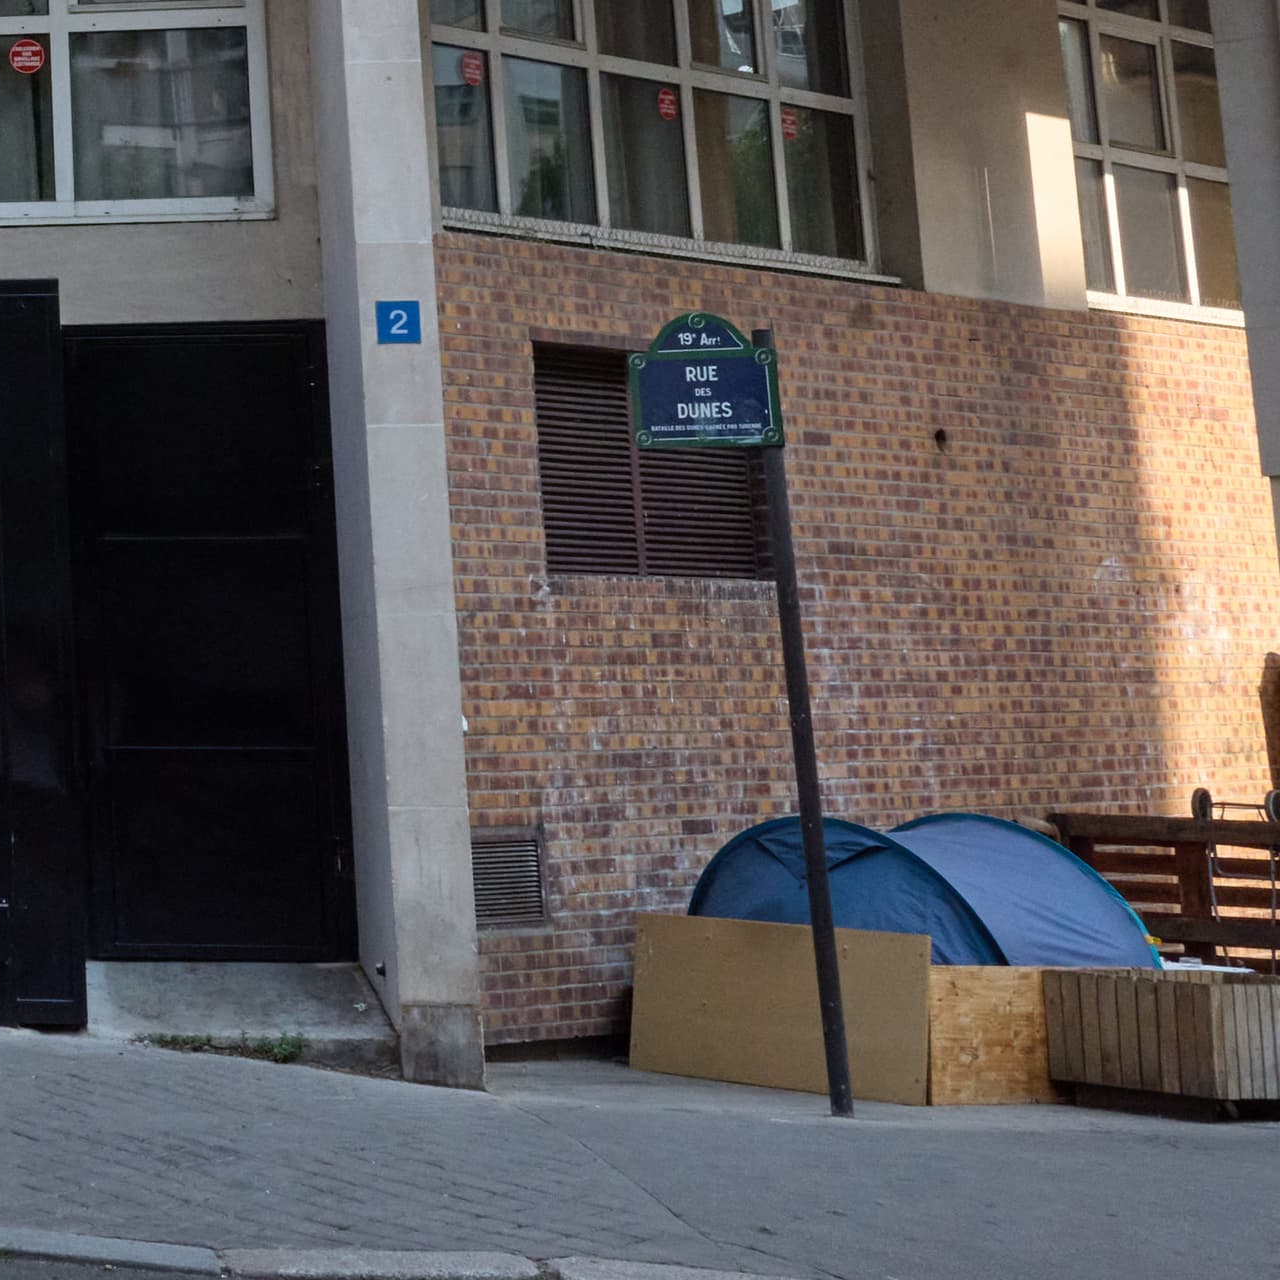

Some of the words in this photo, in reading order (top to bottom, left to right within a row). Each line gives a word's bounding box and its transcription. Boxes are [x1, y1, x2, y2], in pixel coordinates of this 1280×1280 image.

[390, 310, 408, 334] 2
[685, 365, 719, 382] RUE
[694, 387, 712, 396] DES
[677, 402, 733, 419] DUNES
